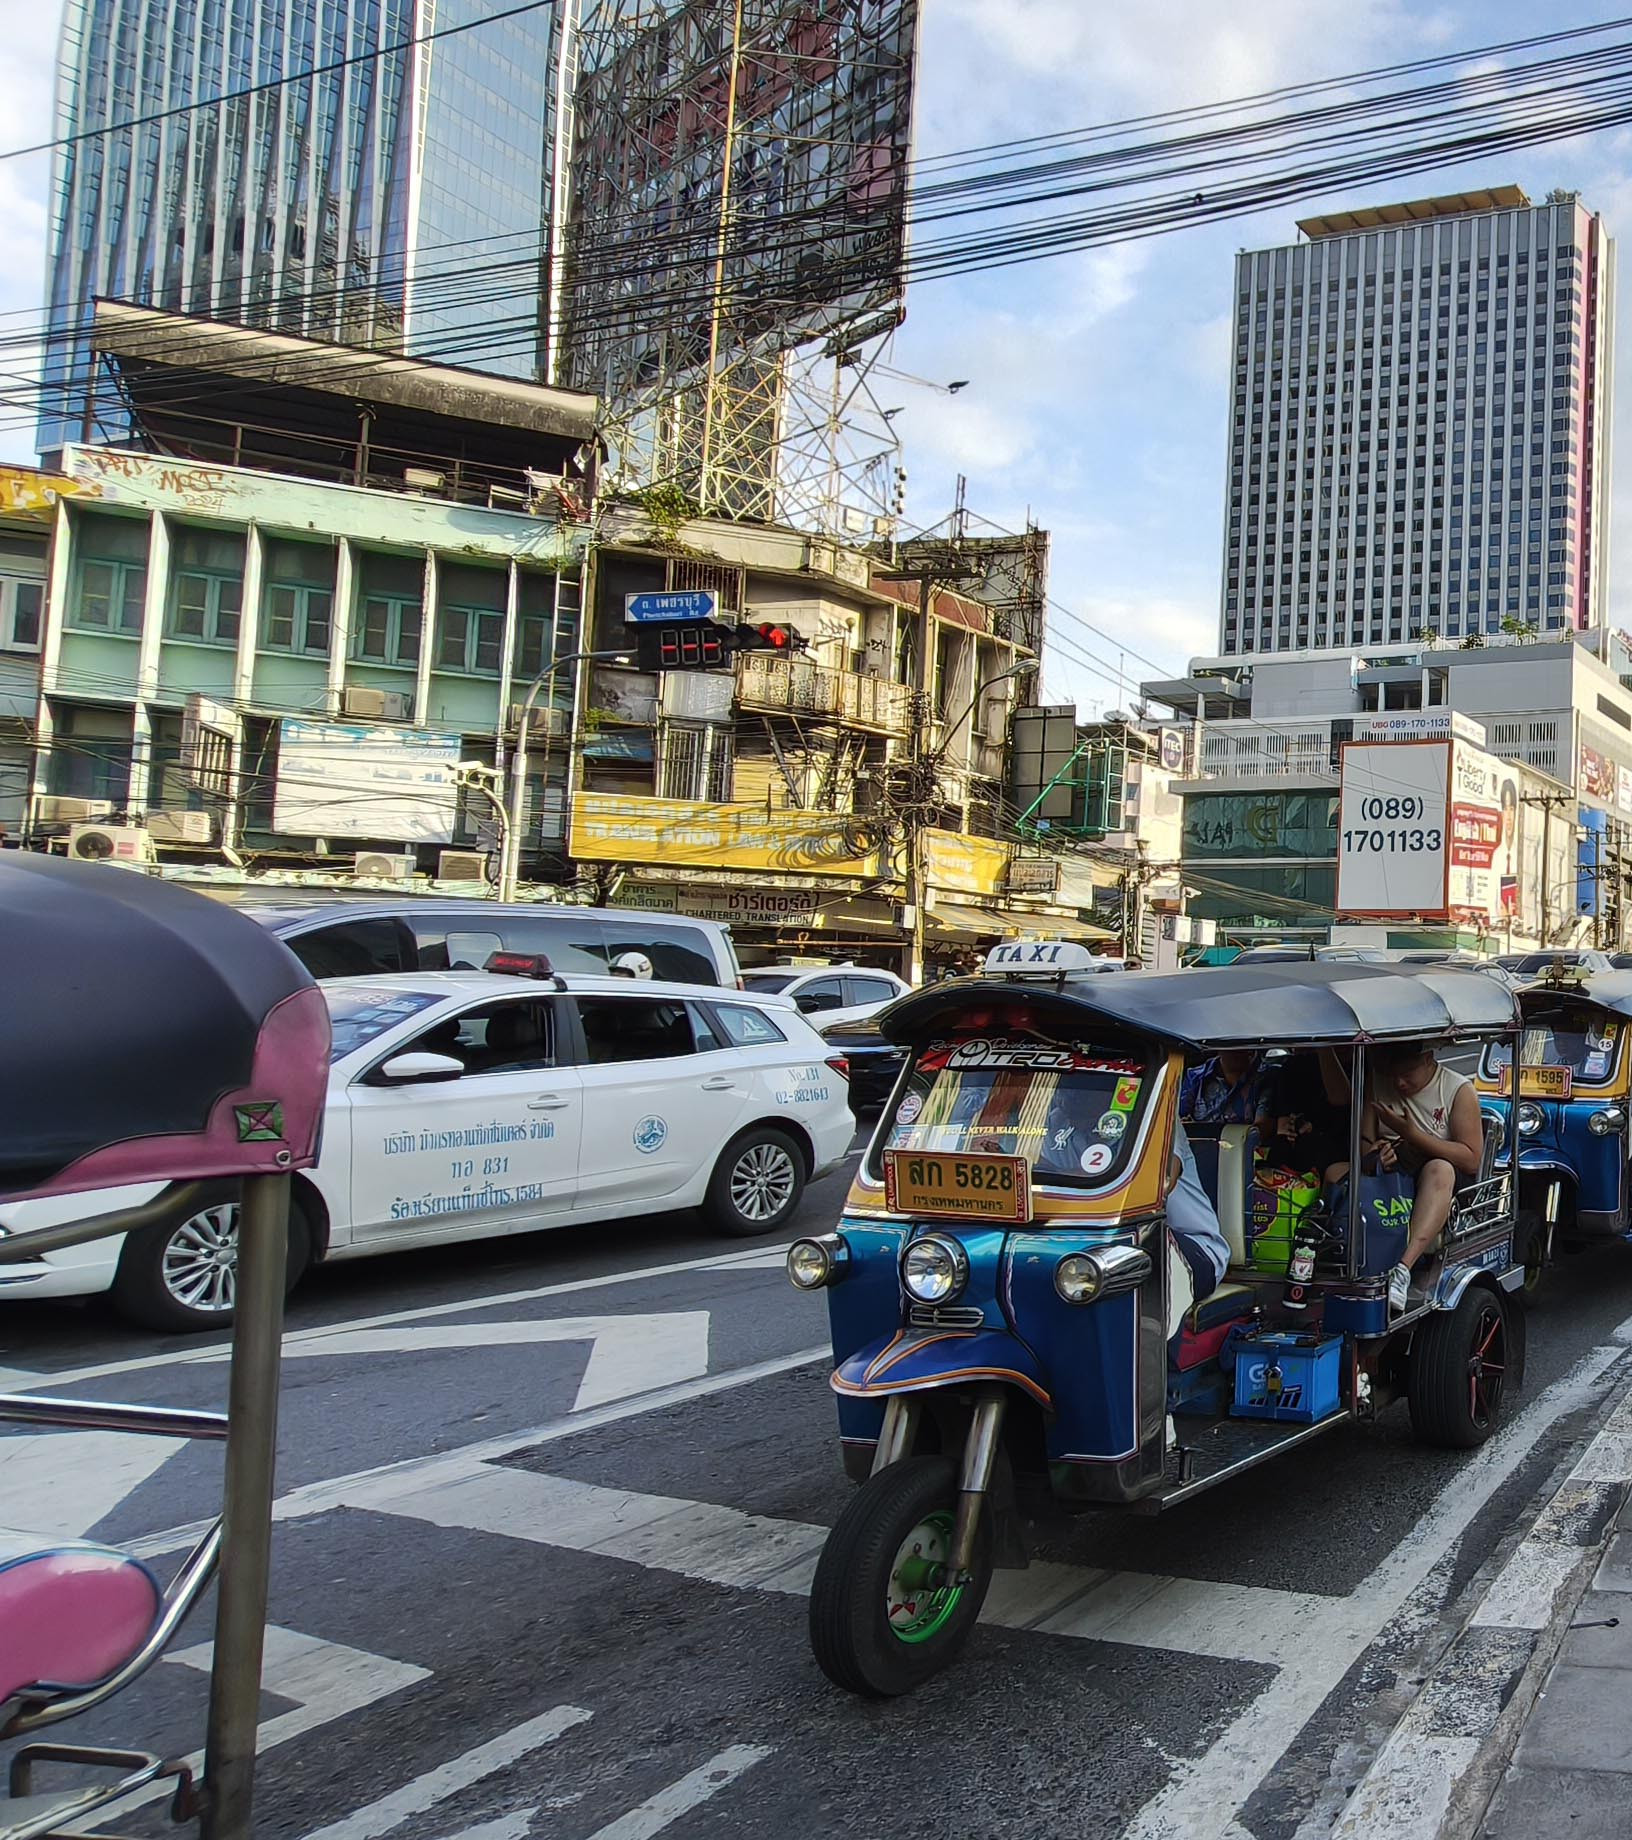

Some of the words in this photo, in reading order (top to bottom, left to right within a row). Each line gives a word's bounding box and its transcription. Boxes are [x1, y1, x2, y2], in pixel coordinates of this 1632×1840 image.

[1389, 719, 1450, 728] 089-170-1133
[1361, 796, 1424, 821] (089)
[1343, 829, 1441, 852] 1701133
[685, 908, 741, 921] CHARTERED
[745, 912, 810, 925] TRANSLATION
[996, 945, 1062, 963] TAXI
[1600, 1040, 1612, 1049] 15
[1535, 1070, 1564, 1084] 1595
[530, 1118, 555, 1140] จำกัด
[483, 1157, 509, 1175] 831
[1089, 1151, 1105, 1166] 2
[908, 1159, 943, 1187] สก
[955, 1162, 1013, 1191] 5828
[912, 1195, 1005, 1211] กรุงเทพมหานคร
